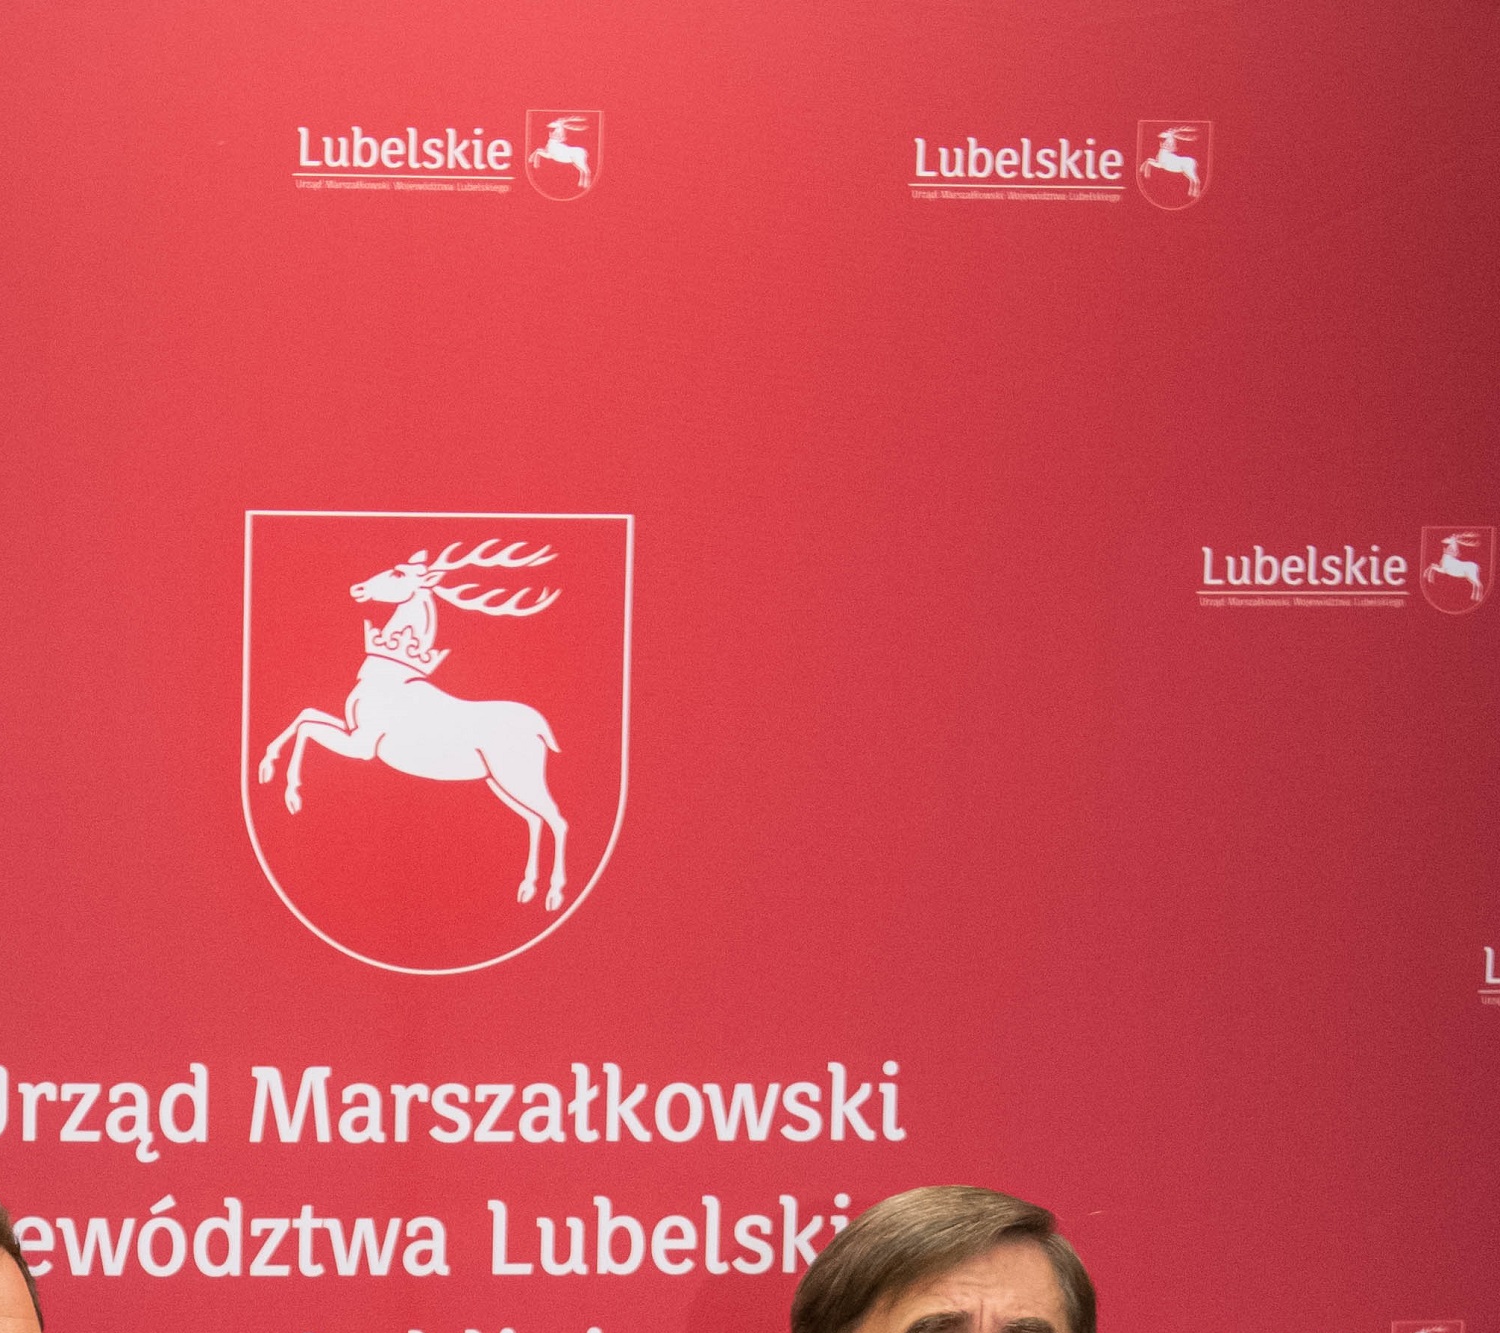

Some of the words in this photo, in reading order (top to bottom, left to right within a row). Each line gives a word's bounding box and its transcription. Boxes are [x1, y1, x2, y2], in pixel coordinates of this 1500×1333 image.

[297, 126, 512, 171] Lubelskie
[914, 137, 1123, 180] Lubelskie
[1201, 545, 1407, 586] Lubelskie
[249, 1060, 906, 1144] Marszałkowski
[12, 1195, 450, 1278] ewództwa
